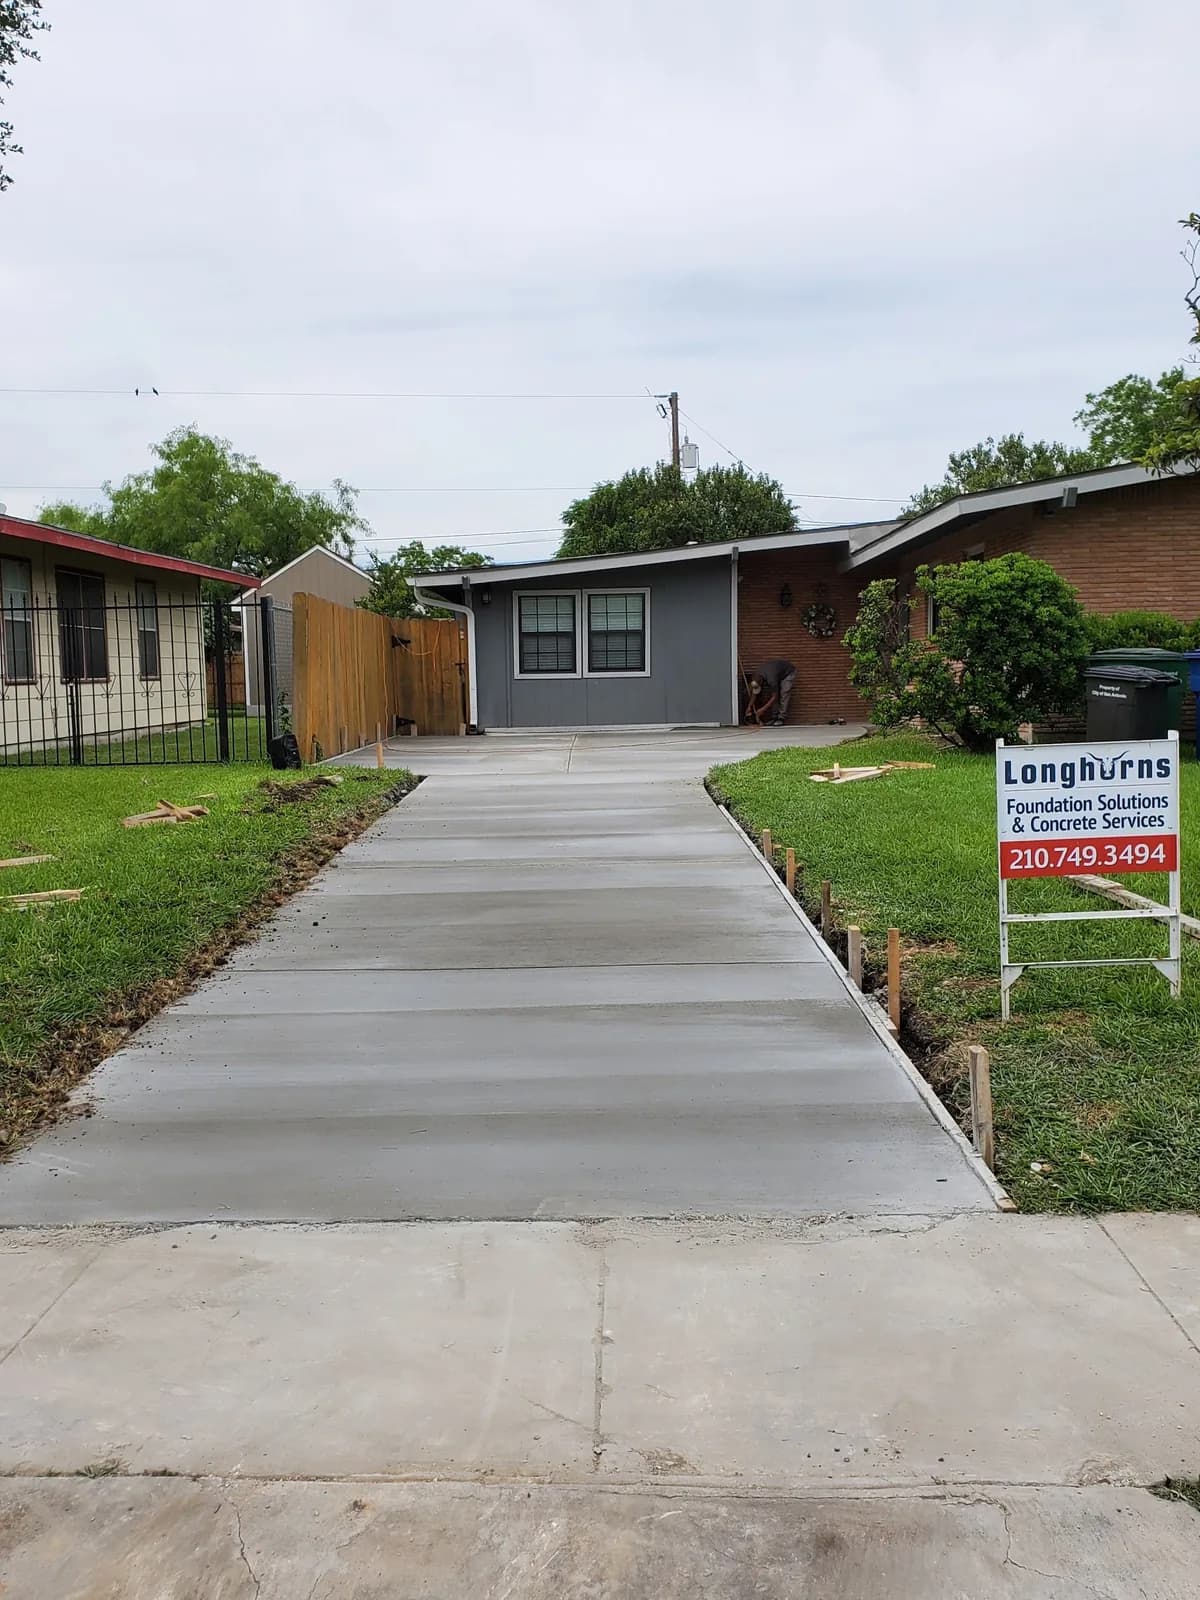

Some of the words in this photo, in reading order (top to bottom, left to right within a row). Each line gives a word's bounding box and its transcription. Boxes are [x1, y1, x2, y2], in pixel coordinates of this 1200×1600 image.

[1004, 757, 1171, 789] Longhorns
[1007, 796, 1093, 815] Foundation
[1098, 793, 1169, 811] Solutions
[1012, 817, 1025, 833] &
[1031, 815, 1097, 832] Concrete
[1102, 812, 1165, 830] Services
[1009, 843, 1166, 870] 210.749.3494
